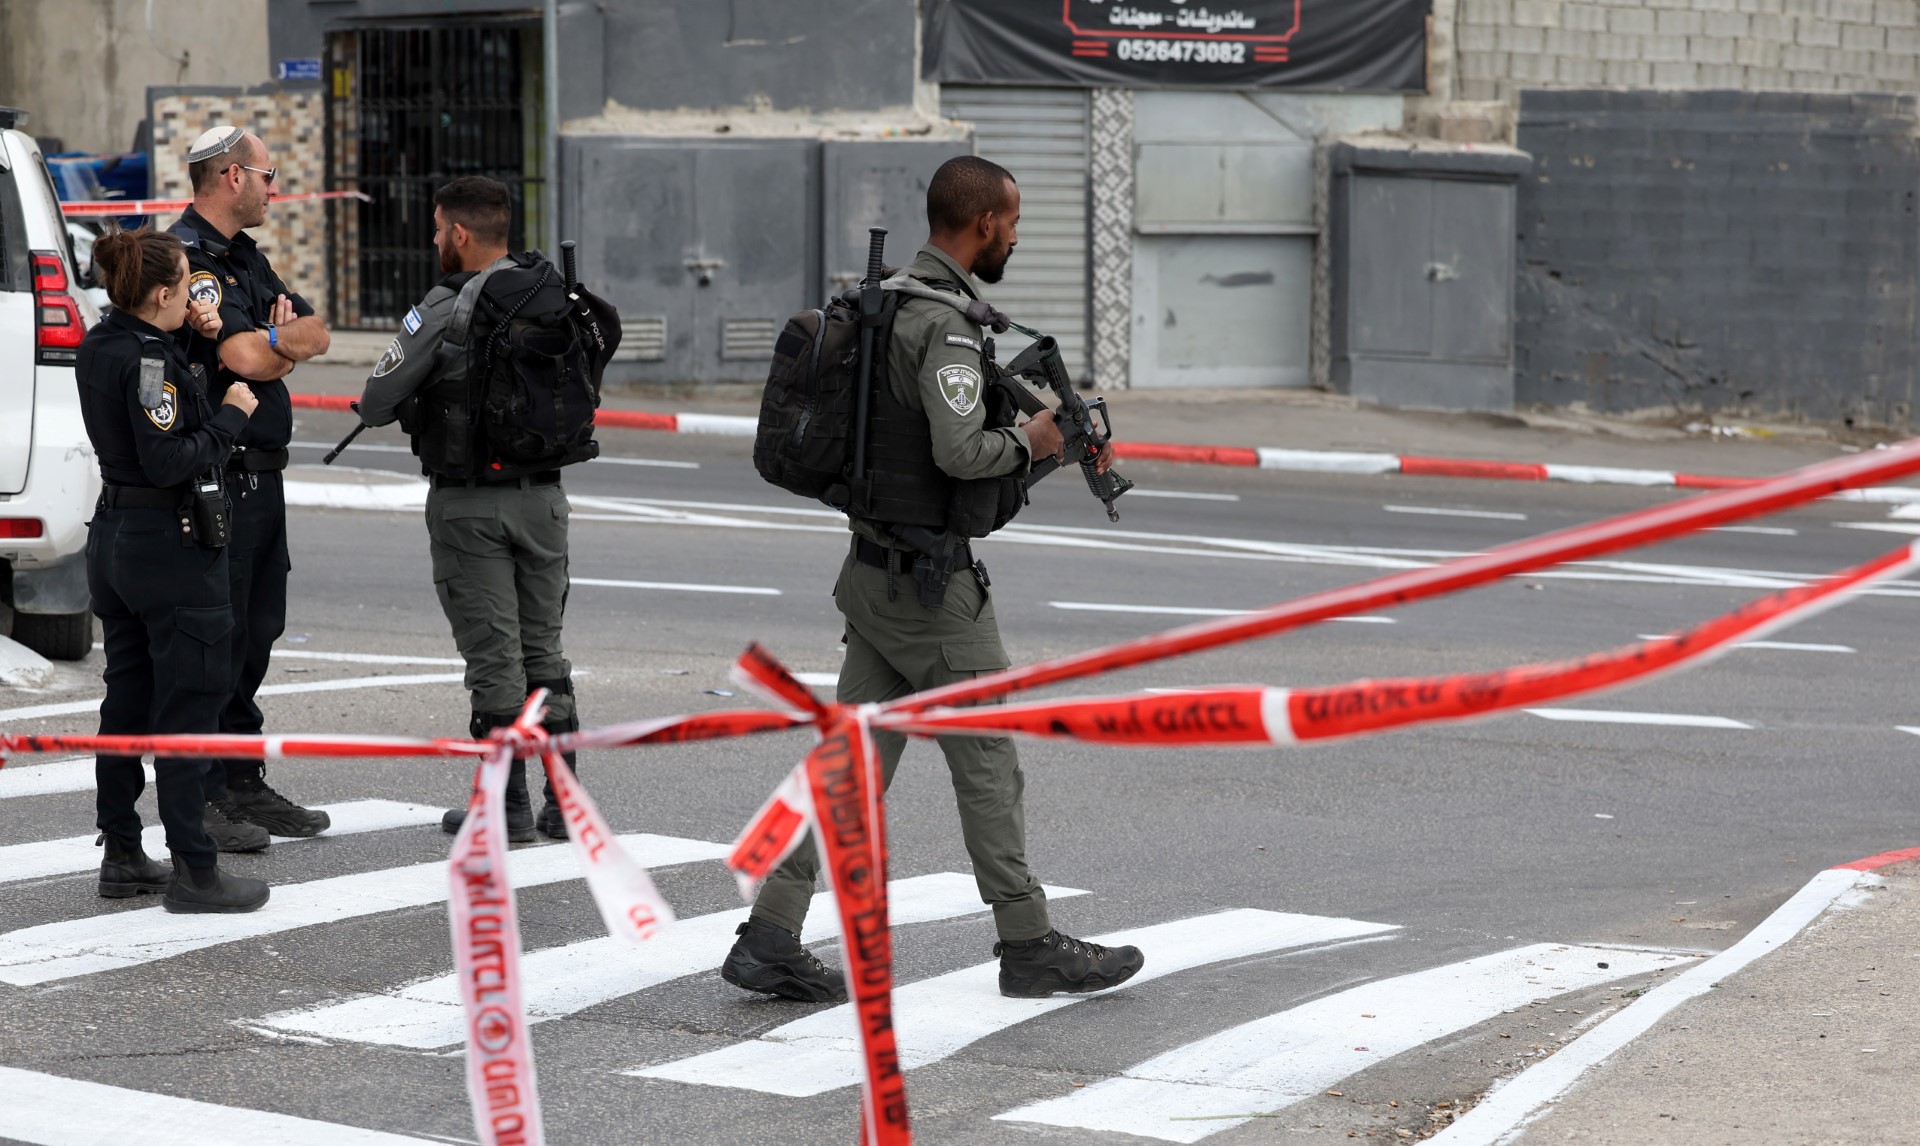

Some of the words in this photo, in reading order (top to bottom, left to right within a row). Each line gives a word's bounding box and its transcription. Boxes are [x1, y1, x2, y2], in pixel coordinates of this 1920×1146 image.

[1117, 39, 1245, 63] 0526473082
[591, 321, 605, 351] POLICE
[1152, 702, 1248, 733] מעבר
[469, 915, 506, 1003] מעבר
